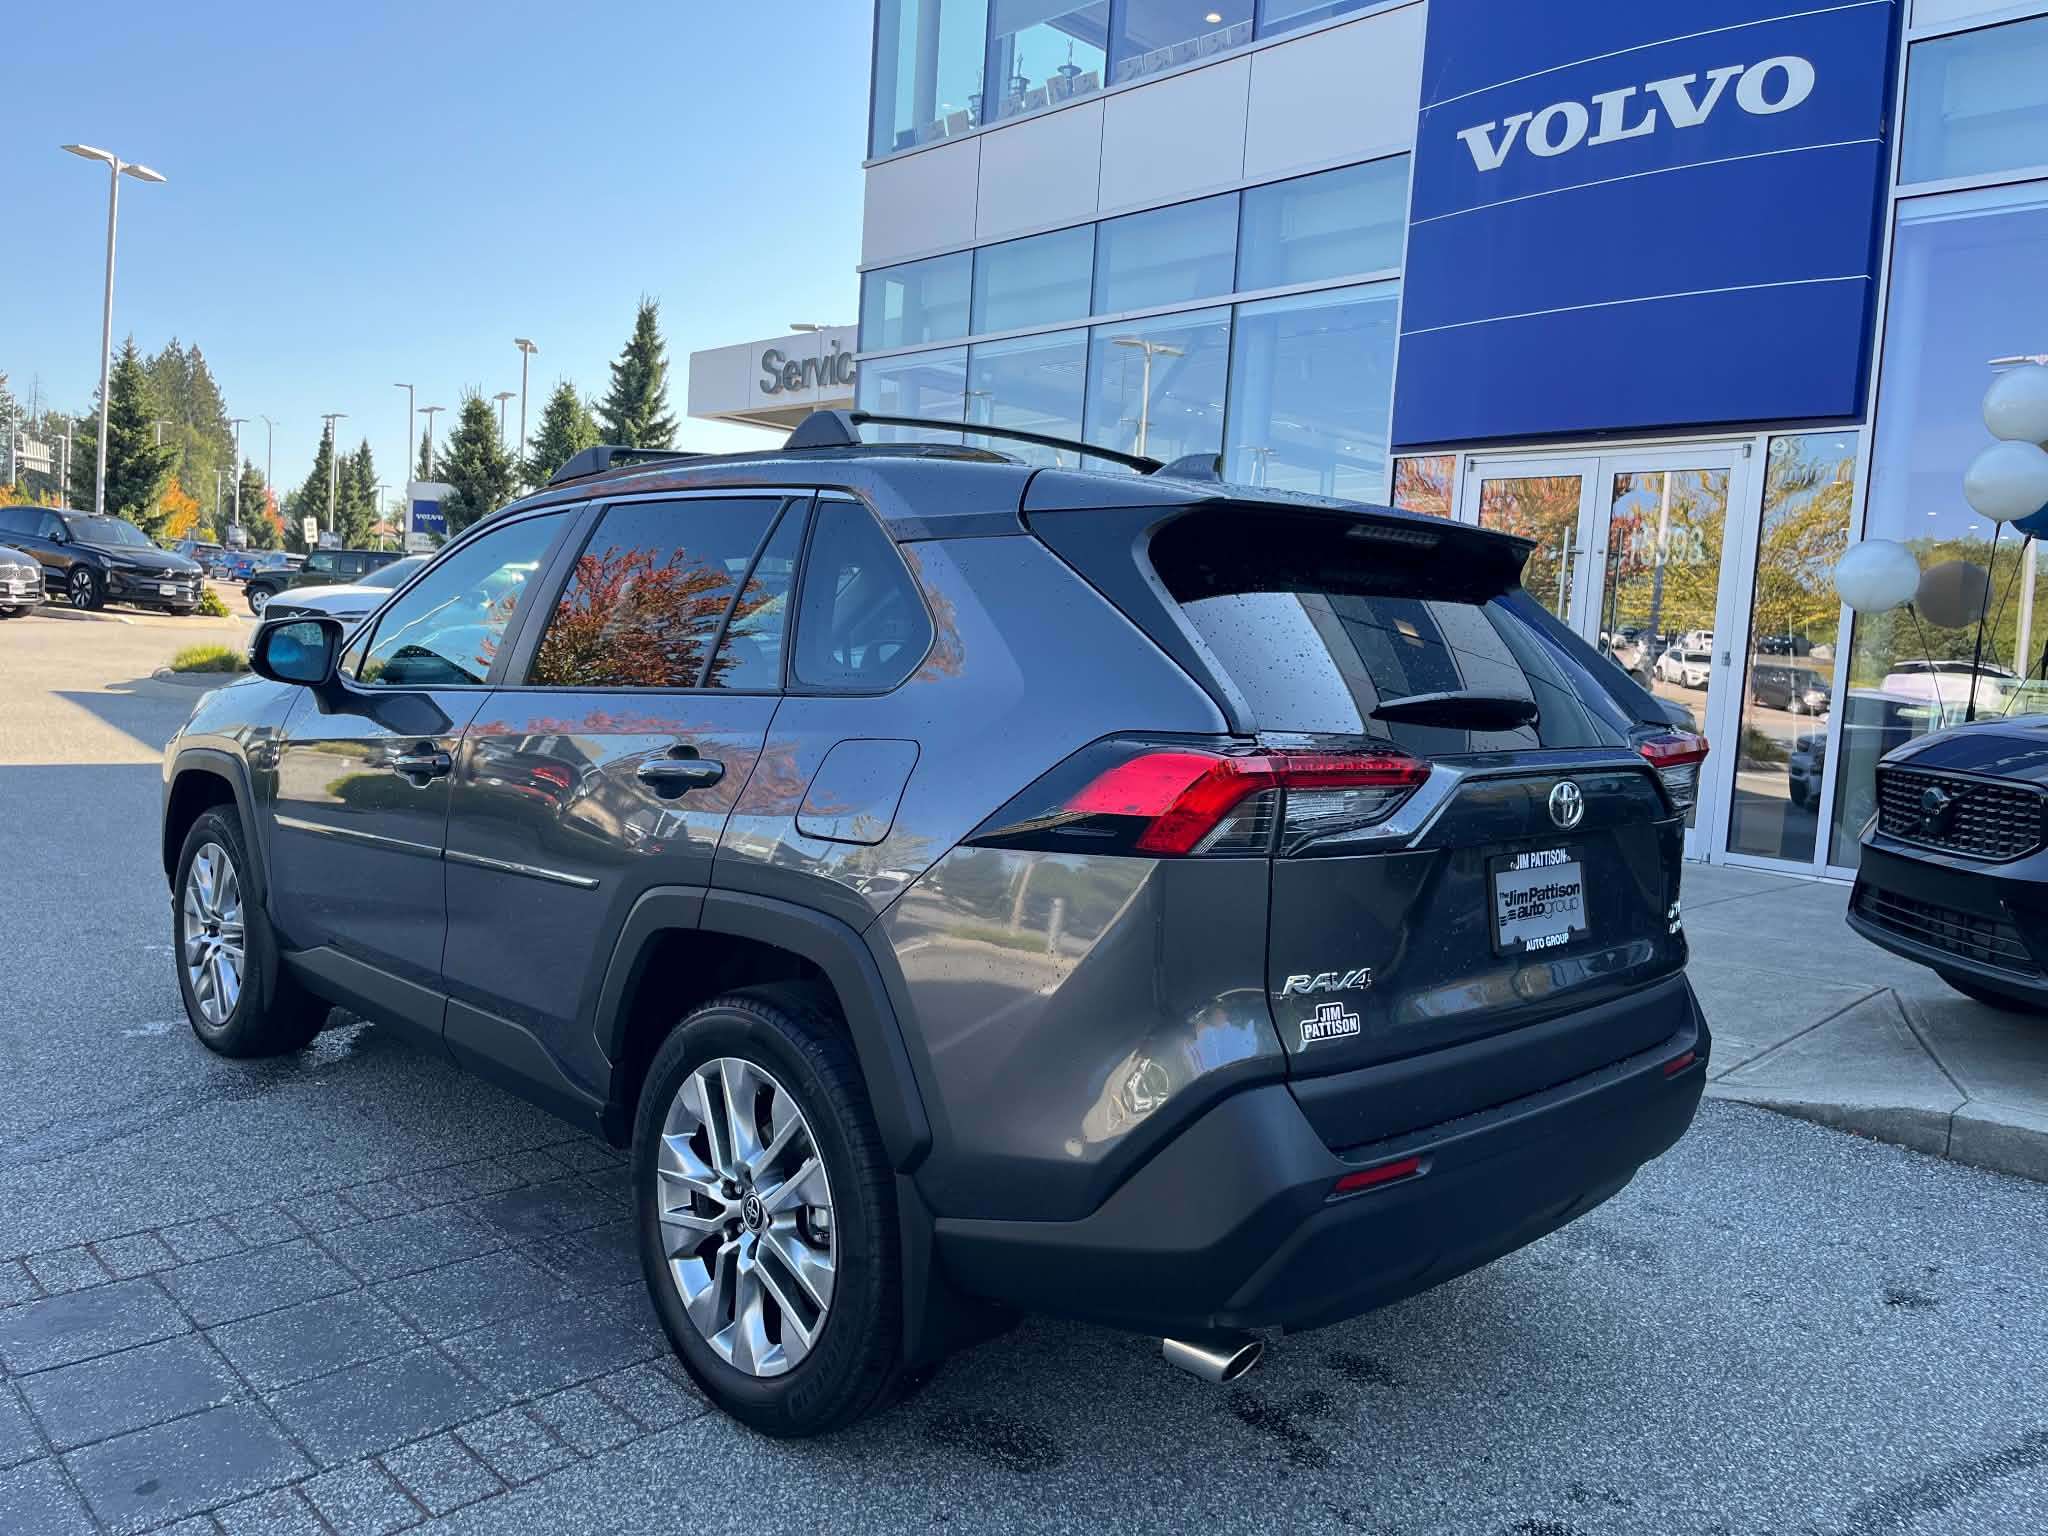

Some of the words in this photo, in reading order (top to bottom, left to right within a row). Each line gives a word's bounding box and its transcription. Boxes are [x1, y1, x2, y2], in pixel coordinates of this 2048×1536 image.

[1456, 55, 1816, 173] VOLVO
[760, 339, 857, 394] Servic
[1515, 853, 1529, 870] JIM
[1530, 848, 1567, 868] PATTISON
[1526, 937, 1545, 952] AUTO
[1545, 932, 1569, 947] GROUP
[1282, 967, 1372, 994] RAV4
[1320, 1006, 1341, 1023] JIM
[1304, 1017, 1357, 1039] PATTISON
